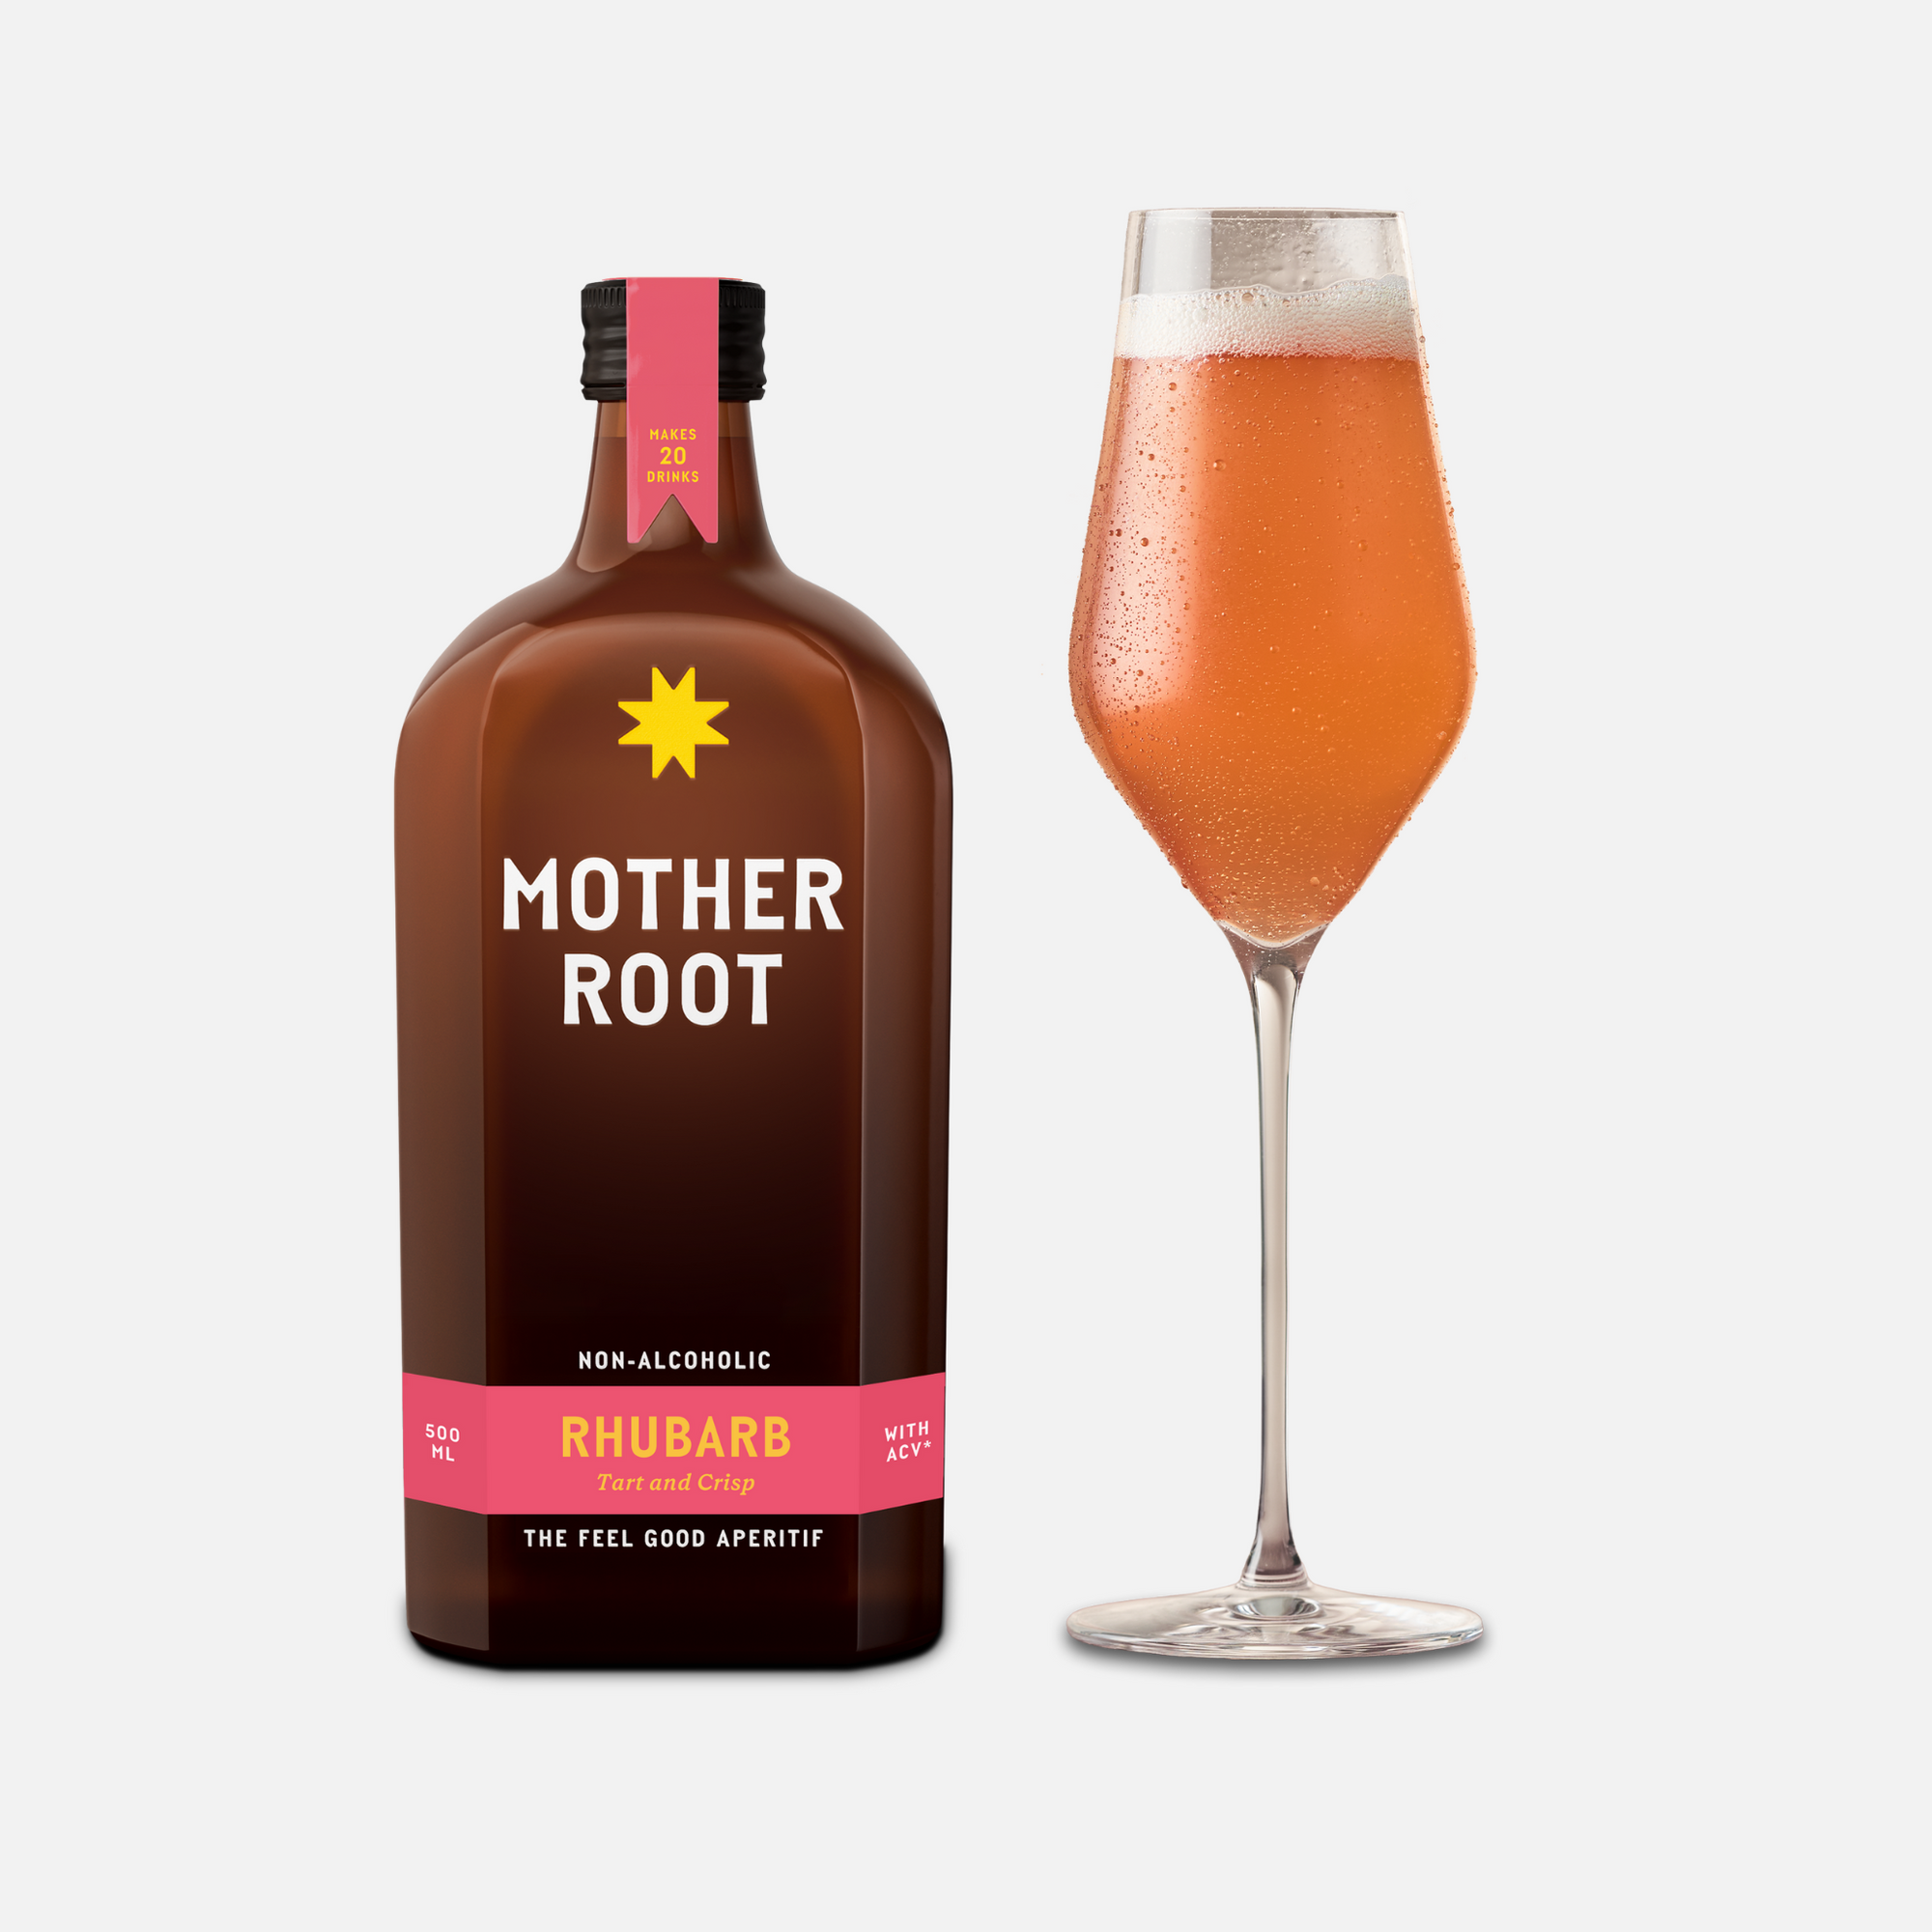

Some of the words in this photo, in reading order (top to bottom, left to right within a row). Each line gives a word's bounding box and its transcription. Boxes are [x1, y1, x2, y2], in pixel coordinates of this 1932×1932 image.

[649, 428, 696, 440] MAKES
[660, 446, 687, 466] 20
[647, 470, 699, 483] DRINKS
[502, 857, 844, 931] MOTHER
[563, 952, 783, 1026] ROOT
[579, 1350, 771, 1370] NON-ALCOHOLIC
[425, 1423, 460, 1443] 500
[562, 1415, 791, 1459] RHUBARB
[884, 1420, 929, 1442] WITH
[432, 1443, 455, 1463] ML
[597, 1473, 645, 1492] Tart
[649, 1472, 693, 1492] and
[697, 1472, 755, 1496] Crisp
[524, 1529, 567, 1548] THE
[579, 1529, 634, 1548] FEEL
[644, 1528, 705, 1548] GOOD
[716, 1529, 824, 1548] APERITIF
